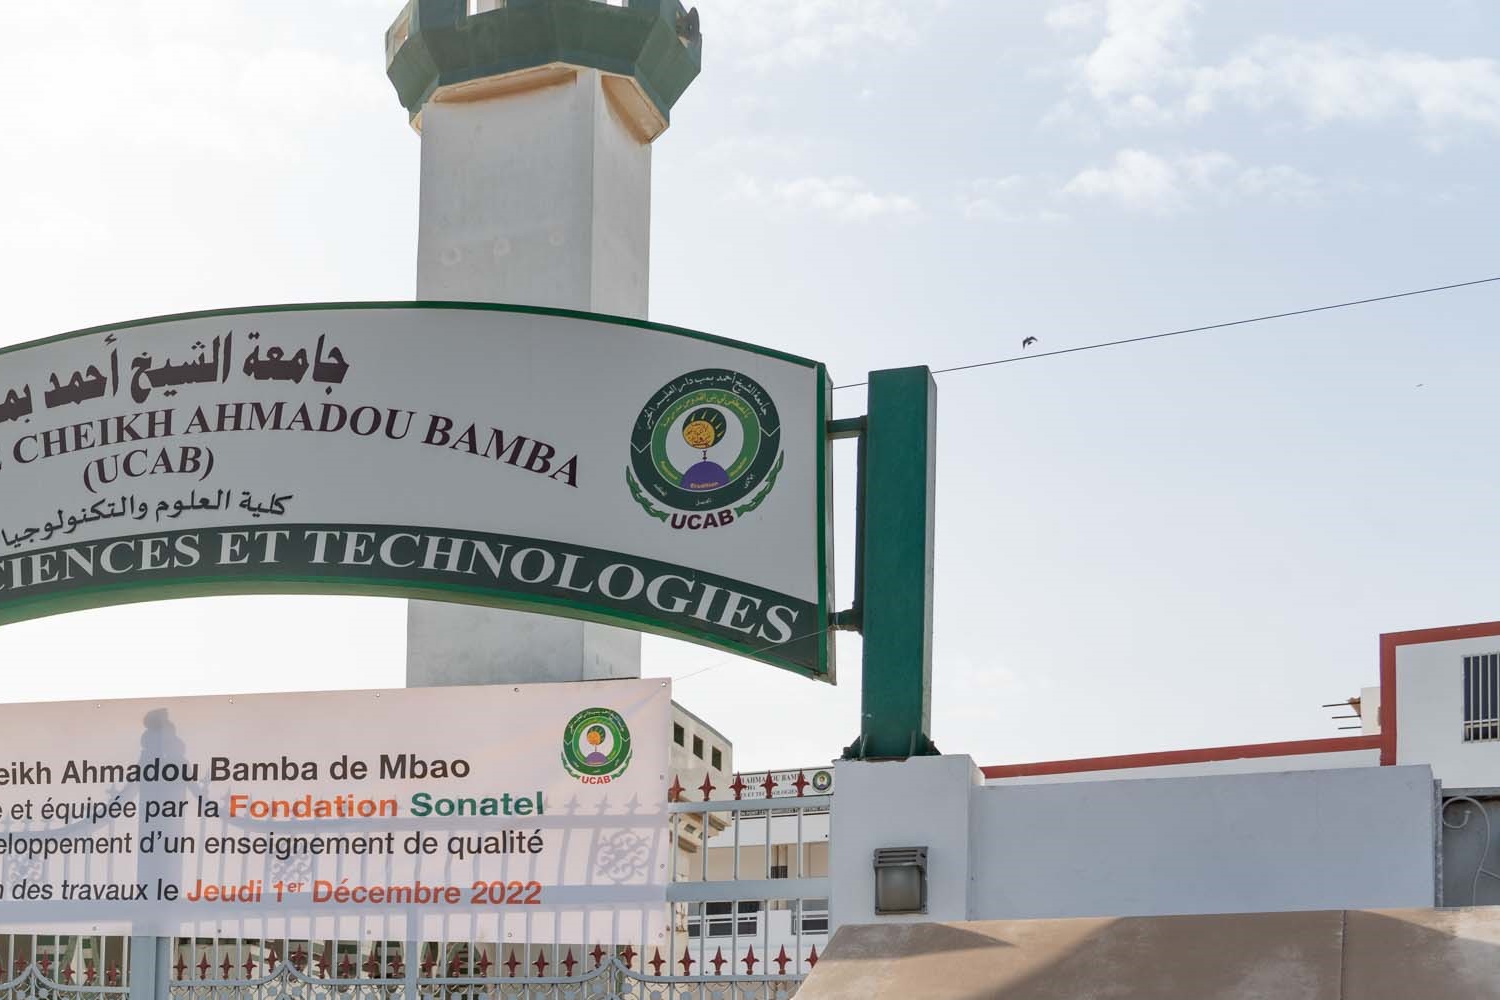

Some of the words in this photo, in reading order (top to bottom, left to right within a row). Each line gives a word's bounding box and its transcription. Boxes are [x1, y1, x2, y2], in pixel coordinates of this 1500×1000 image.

[44, 333, 120, 409] أحمد
[130, 329, 233, 403] الشيخ
[242, 331, 350, 394] جامعة
[12, 407, 175, 465] CHEIKH
[183, 401, 416, 440] AHMADOU
[421, 413, 580, 488] BAMBA
[83, 445, 215, 493] (UCAB)
[155, 489, 231, 523] العلوم
[239, 490, 293, 517] كلية
[670, 509, 734, 530] UCAB
[1, 495, 148, 547] والتكنولوجيا
[217, 530, 290, 565] ET
[303, 530, 800, 643] TECHNOLOGIES
[61, 757, 199, 784] Ahmadou
[210, 756, 318, 782] Bamba
[329, 755, 368, 780] de
[380, 754, 470, 780] Mbao
[581, 775, 611, 784] UCAB
[11, 801, 33, 820] et
[41, 796, 137, 824] équipée
[145, 800, 189, 822] par
[198, 795, 219, 818] la
[229, 794, 398, 818] Fondation
[410, 791, 544, 817] Sonatel
[139, 831, 195, 854] d’un
[204, 832, 394, 860] enseignement
[404, 831, 438, 855] de
[447, 829, 544, 860] qualité
[12, 879, 53, 900] des
[61, 880, 149, 900] travaux
[157, 878, 179, 901] le
[187, 879, 262, 903] Jeudi
[313, 878, 461, 904] Décembre
[470, 881, 542, 905] 2022
